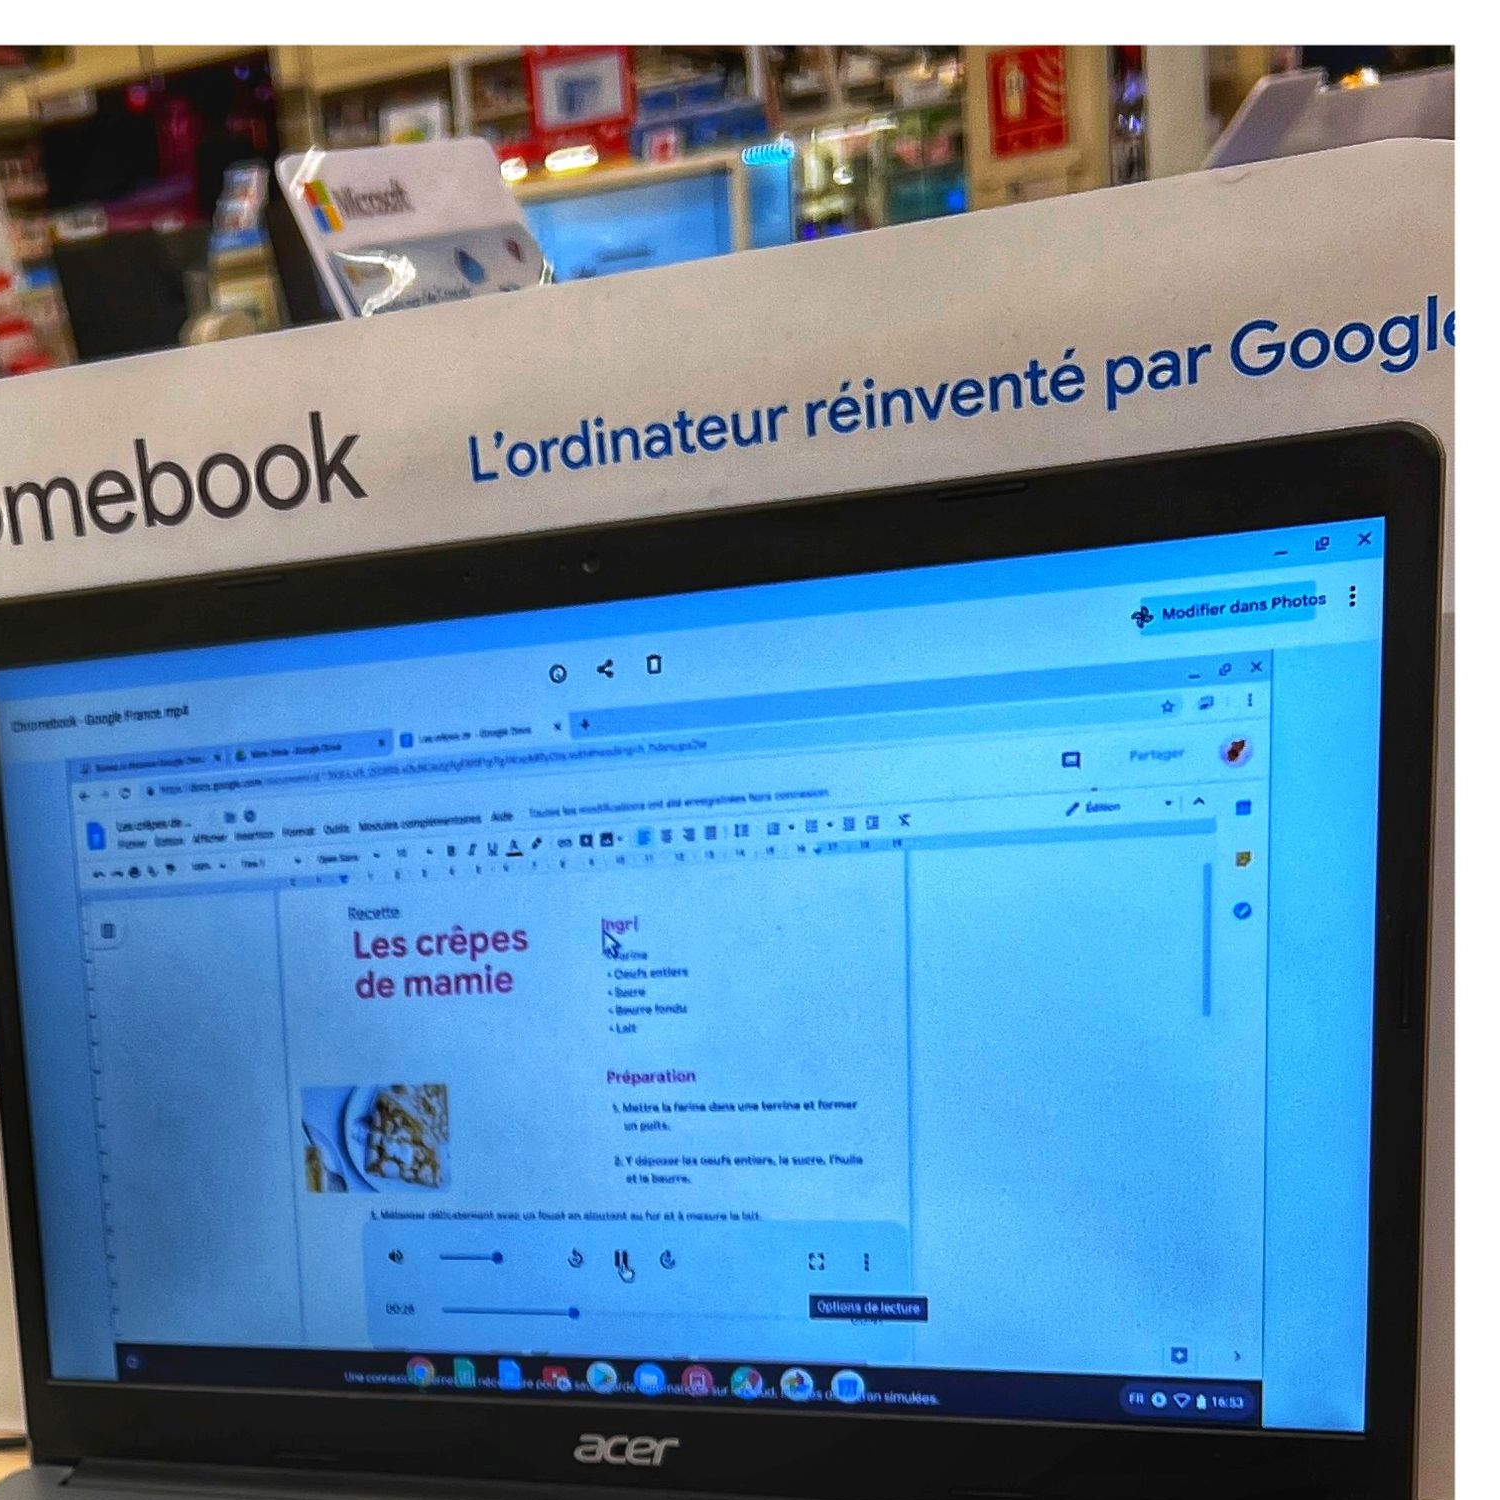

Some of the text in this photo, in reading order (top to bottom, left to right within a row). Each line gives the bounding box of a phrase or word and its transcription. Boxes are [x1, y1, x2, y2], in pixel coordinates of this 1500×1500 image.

[468, 295, 1456, 485] L'ordinateur réinventé par Googl
[1160, 591, 1328, 622] Modifier dans Photos
[1128, 744, 1185, 764] Partager
[347, 906, 400, 922] Recette
[352, 925, 529, 961] Les crêpes
[355, 964, 514, 1000] de mamie
[614, 987, 646, 998] Sucre
[615, 1005, 652, 1017] Beurre
[616, 1023, 637, 1035] Lait
[606, 1069, 697, 1088] Préparation
[622, 1103, 659, 1114] Mettre
[708, 1101, 735, 1112] dans
[738, 1103, 759, 1112] une
[803, 1101, 816, 1112] et
[817, 1099, 858, 1111] former
[623, 1121, 637, 1132] un
[816, 1299, 921, 1317] Options de lecture
[1128, 1392, 1244, 1410] FR 16:53
[573, 1432, 681, 1467] acer
